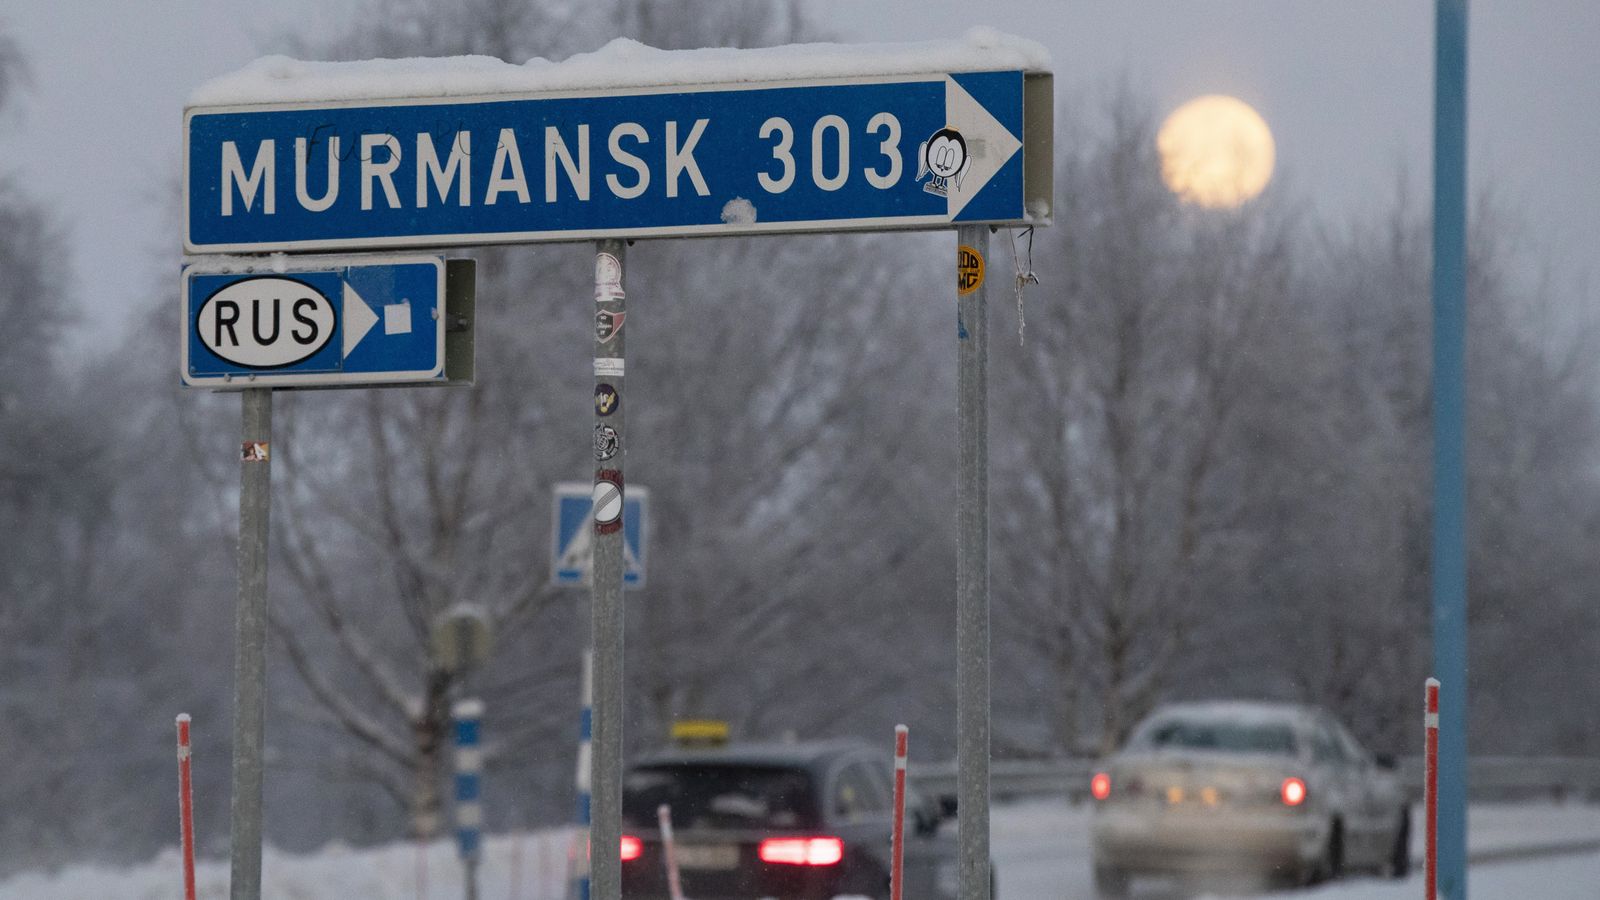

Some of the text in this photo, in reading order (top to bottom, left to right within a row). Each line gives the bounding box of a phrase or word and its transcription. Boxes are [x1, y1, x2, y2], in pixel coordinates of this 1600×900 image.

[220, 111, 904, 217] MURMANSK 303
[213, 297, 320, 348] RUS
